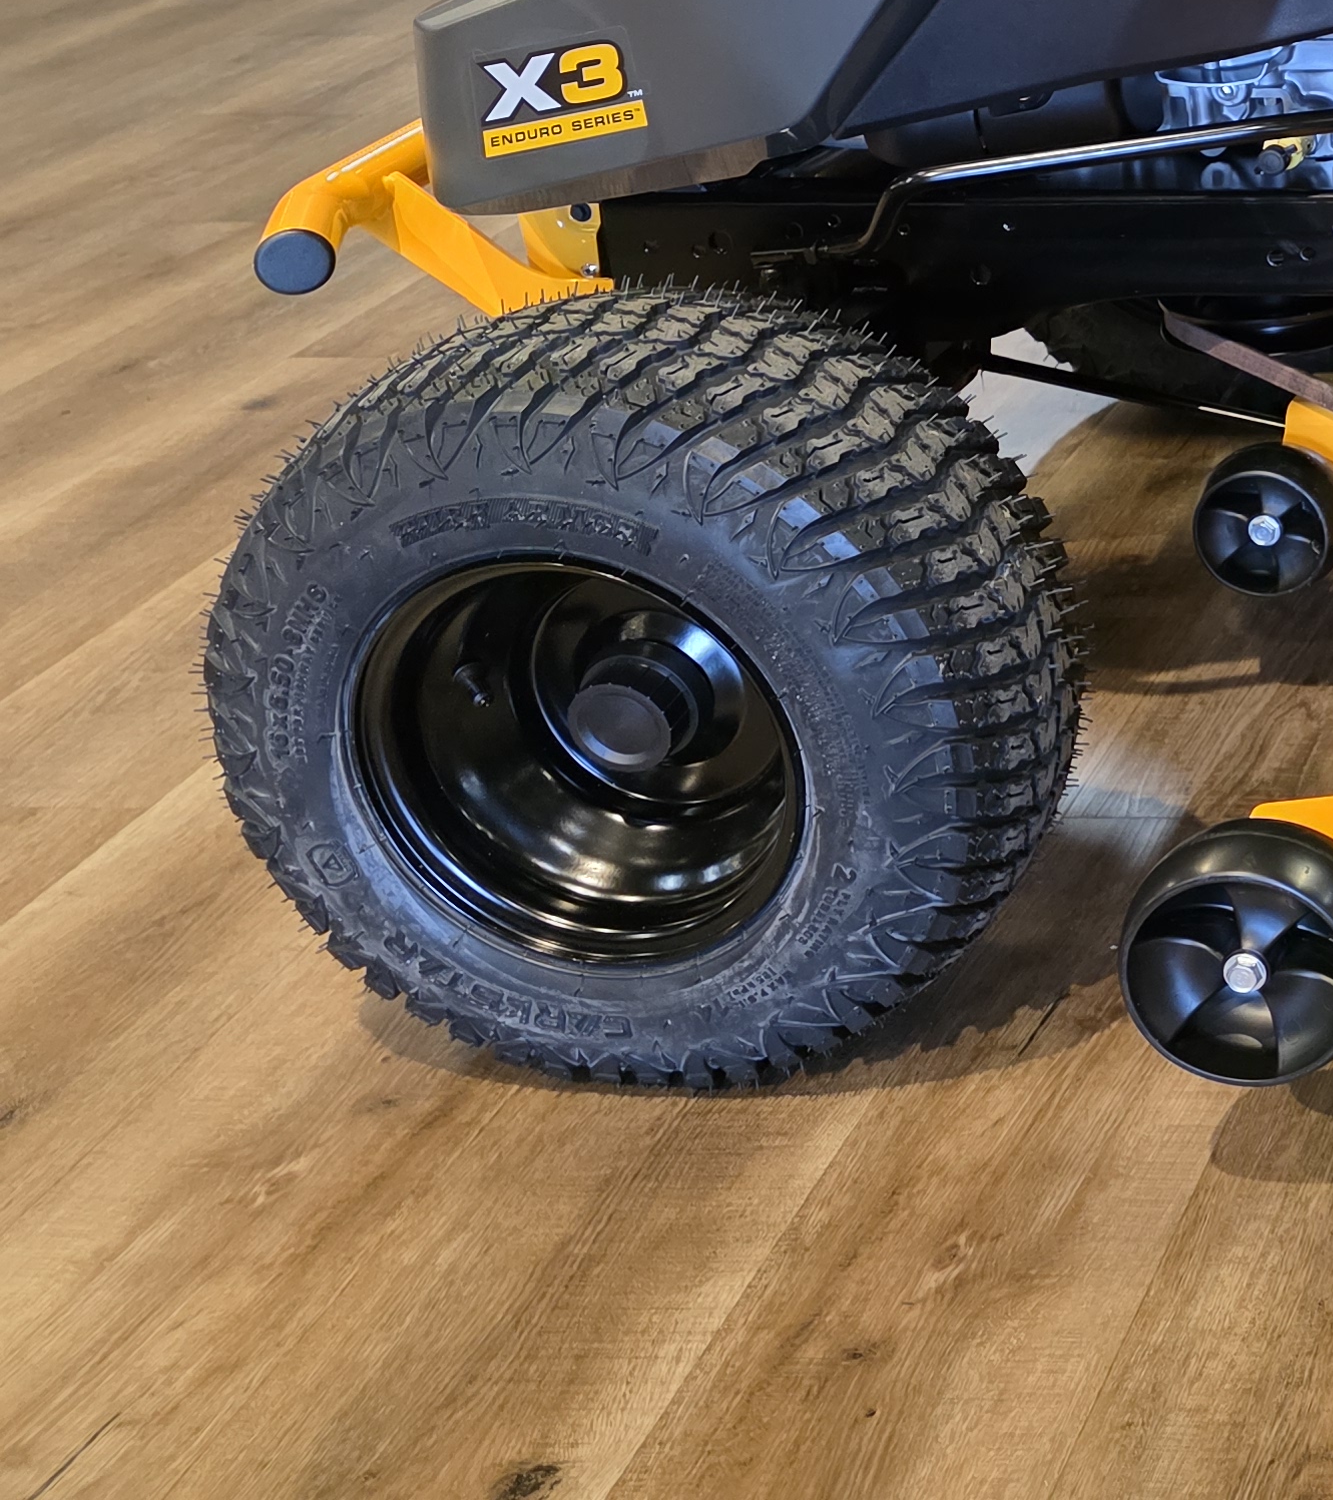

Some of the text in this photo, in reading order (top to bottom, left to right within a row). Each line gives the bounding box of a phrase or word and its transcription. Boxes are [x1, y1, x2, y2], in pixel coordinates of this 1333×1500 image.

[483, 43, 623, 122] X3
[491, 124, 563, 148] ENDURO
[833, 864, 857, 885] 2
